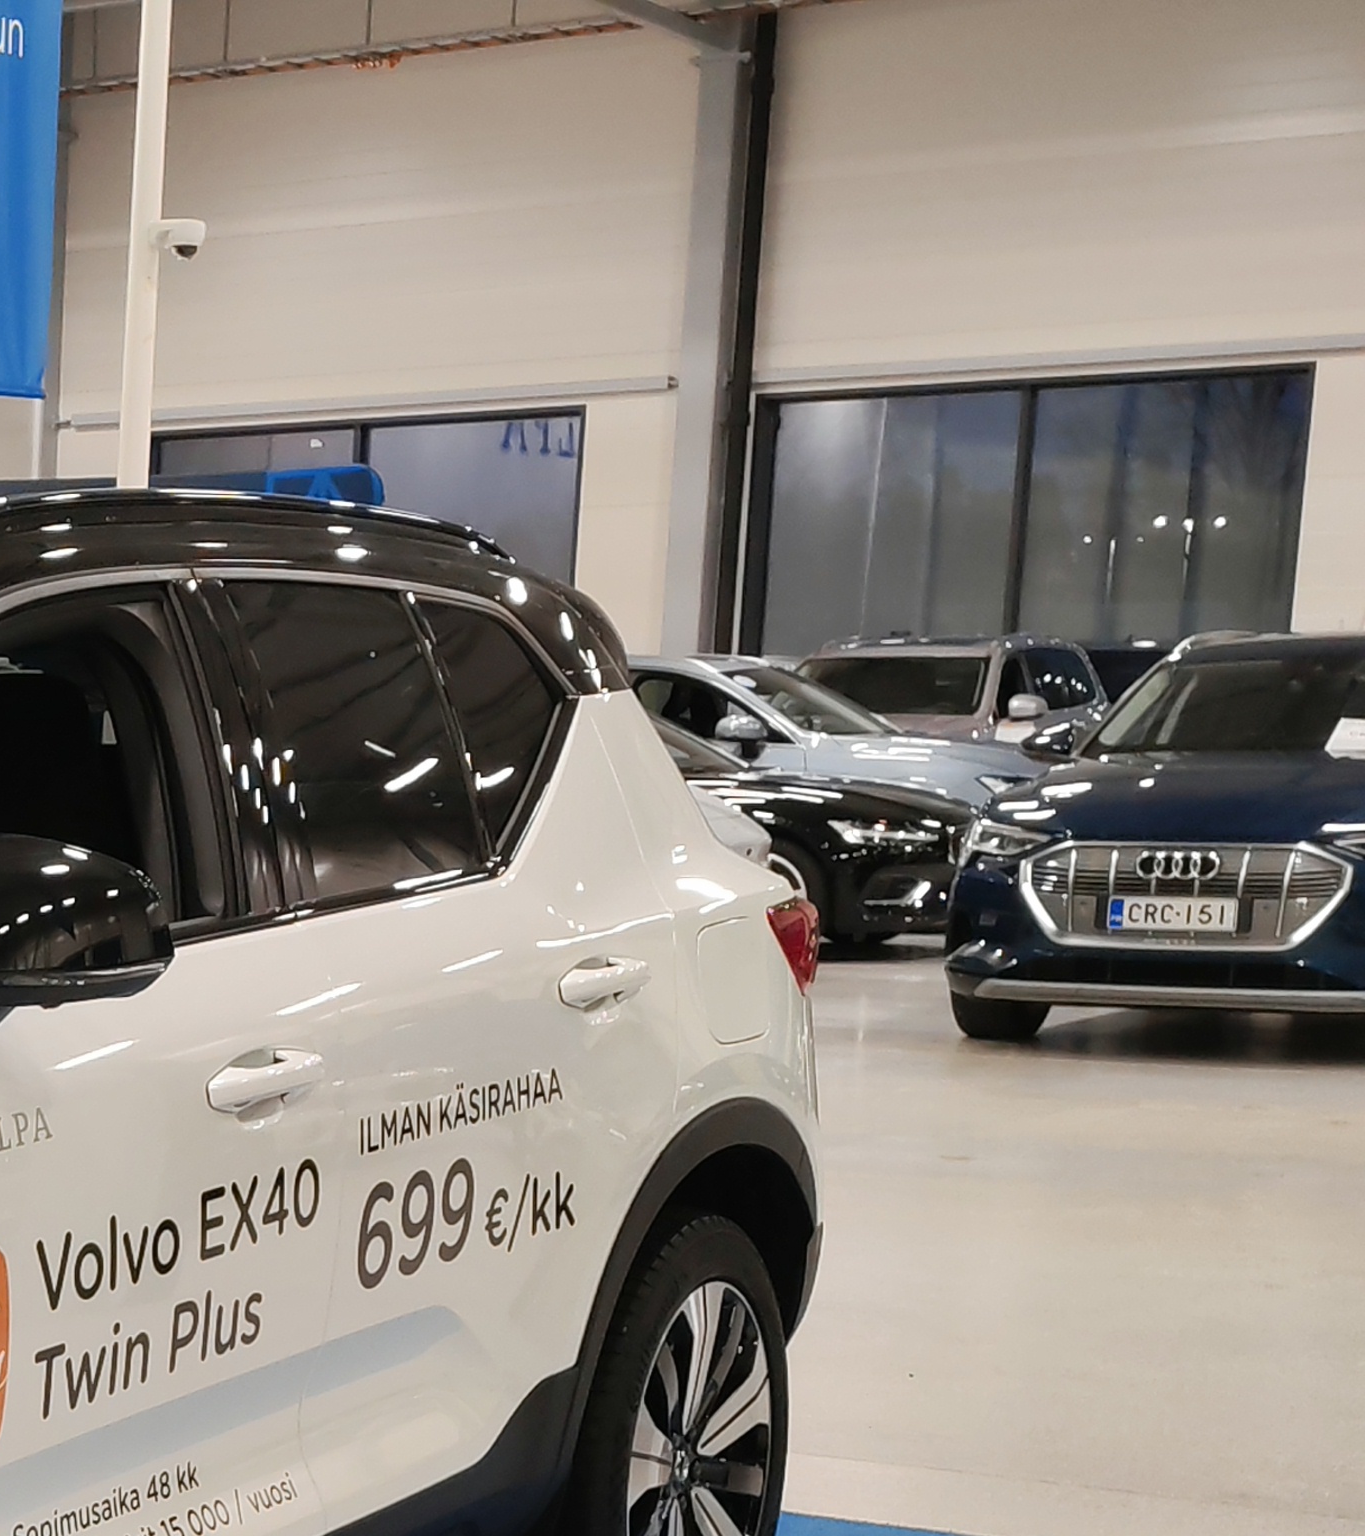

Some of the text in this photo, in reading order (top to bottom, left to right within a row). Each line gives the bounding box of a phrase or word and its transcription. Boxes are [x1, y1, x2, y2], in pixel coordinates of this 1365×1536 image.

[1127, 903, 1225, 925] CRC-151
[359, 1067, 564, 1156] ILMAN KÄSIRAHAA
[36, 1157, 321, 1312] Volvo EX40
[357, 1157, 475, 1290] 699
[34, 1289, 263, 1420] Twin Plus
[146, 1470, 172, 1503] 48
[176, 1460, 200, 1494] kk
[187, 1498, 232, 1536] 000
[246, 1471, 299, 1514] vuosi
